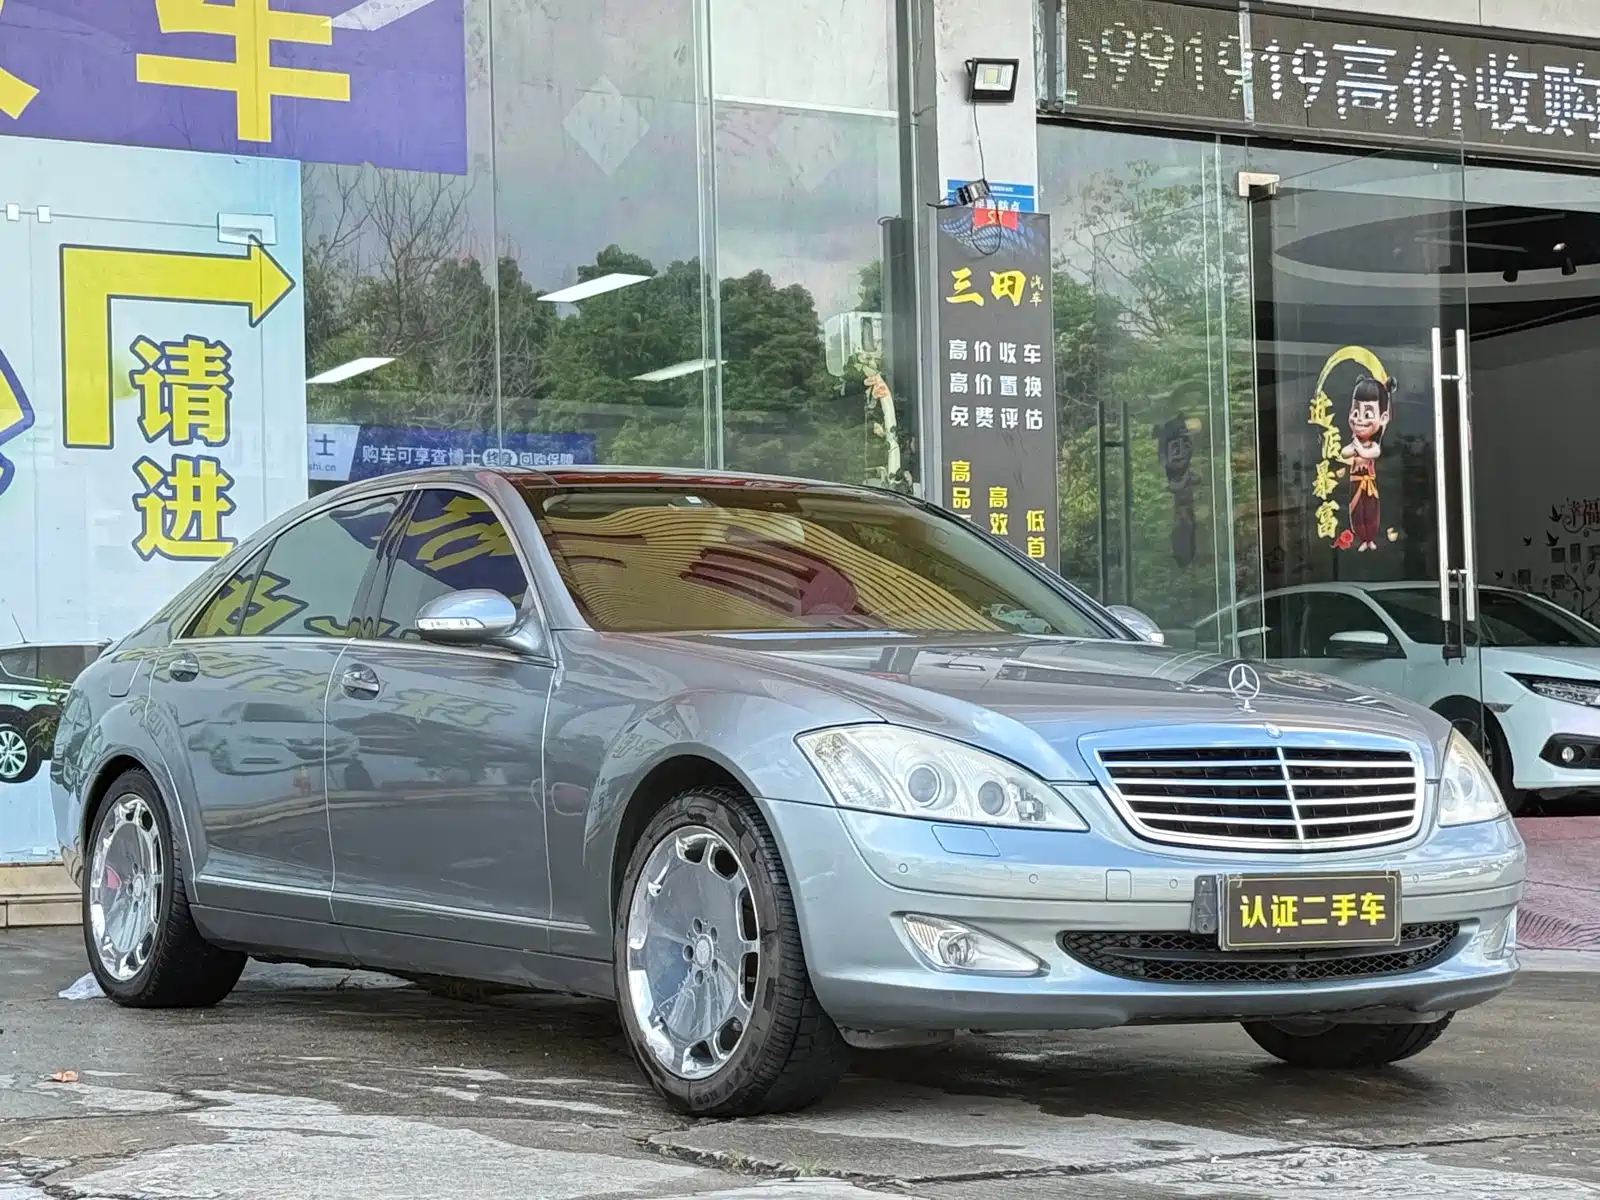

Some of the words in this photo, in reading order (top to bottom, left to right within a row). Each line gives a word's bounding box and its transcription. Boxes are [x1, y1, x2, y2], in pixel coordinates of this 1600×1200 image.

[946, 267, 1027, 307] 三田
[948, 339, 1042, 365] 高价收车
[949, 372, 1043, 398] 高价置换
[950, 405, 1044, 430] 免费评估
[129, 334, 239, 562] 请进
[314, 433, 336, 457] 士
[1307, 390, 1343, 539] 进店暴富
[951, 460, 972, 524] 高品
[988, 486, 1010, 540] 高效
[1026, 509, 1047, 563] 低首
[1239, 892, 1386, 929] 认证二手车
